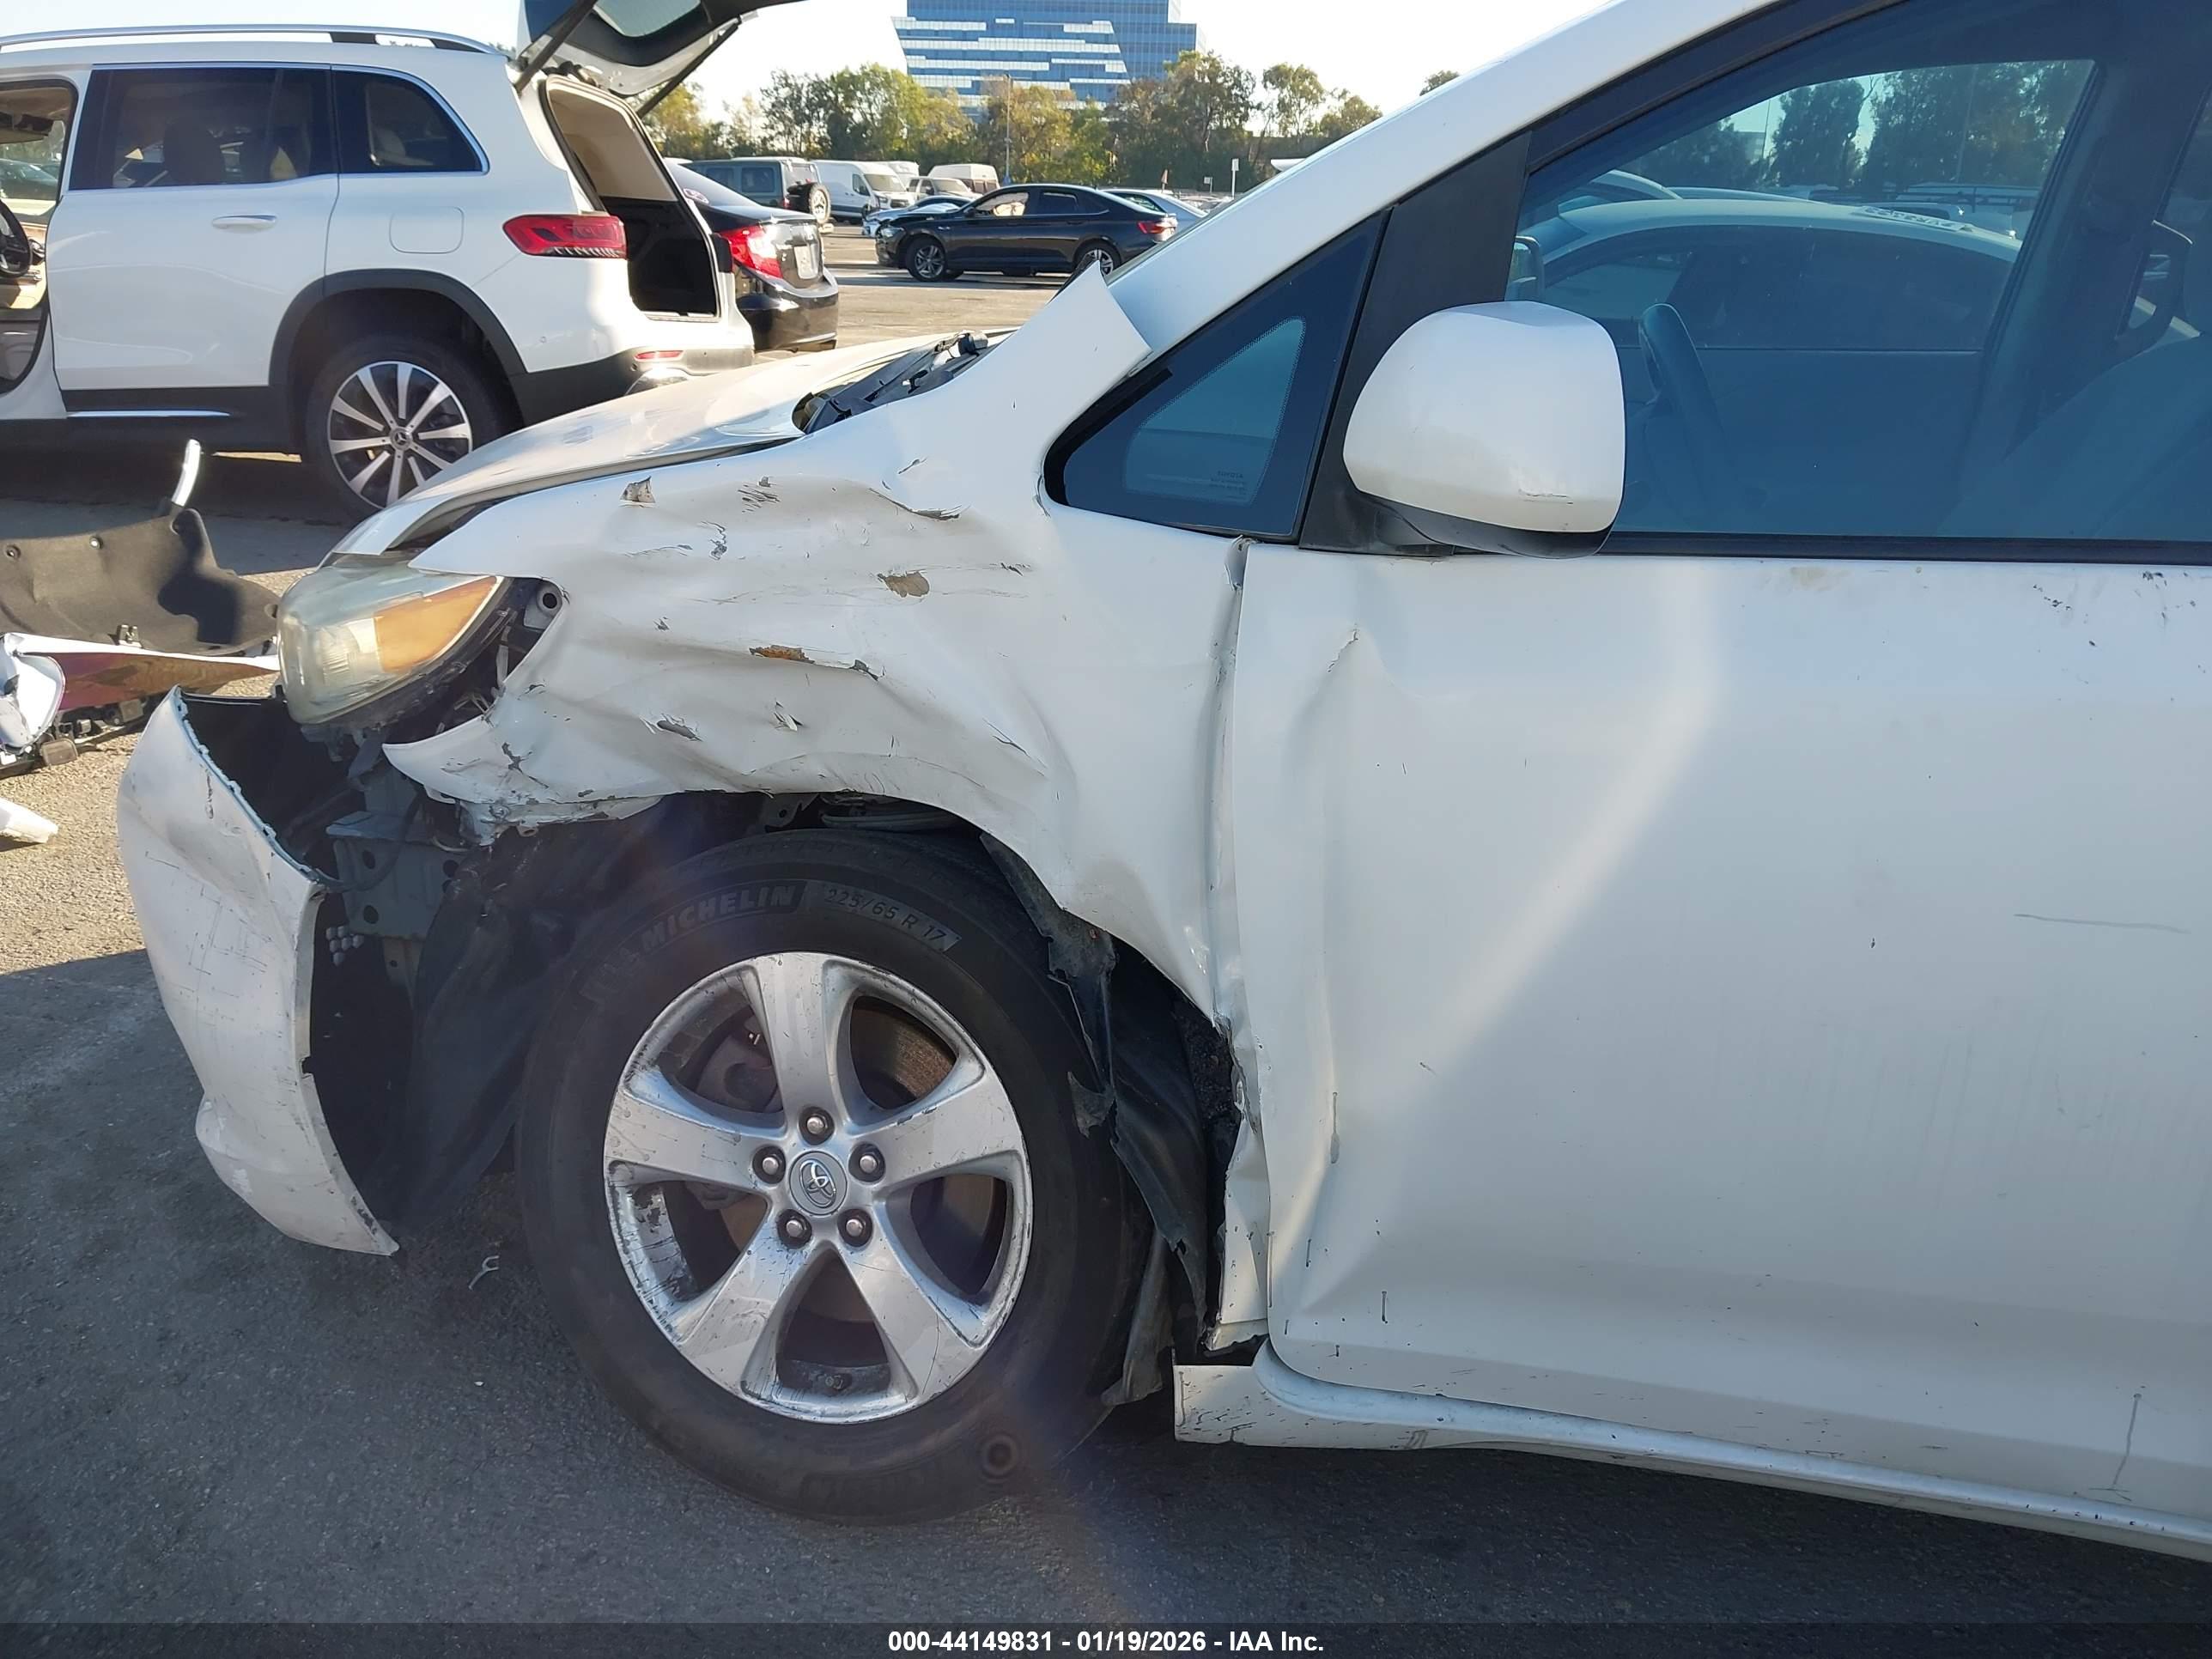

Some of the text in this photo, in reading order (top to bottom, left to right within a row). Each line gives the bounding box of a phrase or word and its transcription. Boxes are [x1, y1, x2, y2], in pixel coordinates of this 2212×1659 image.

[641, 885, 794, 952] MICHELIN
[902, 913, 919, 930] R
[921, 925, 947, 942] 17
